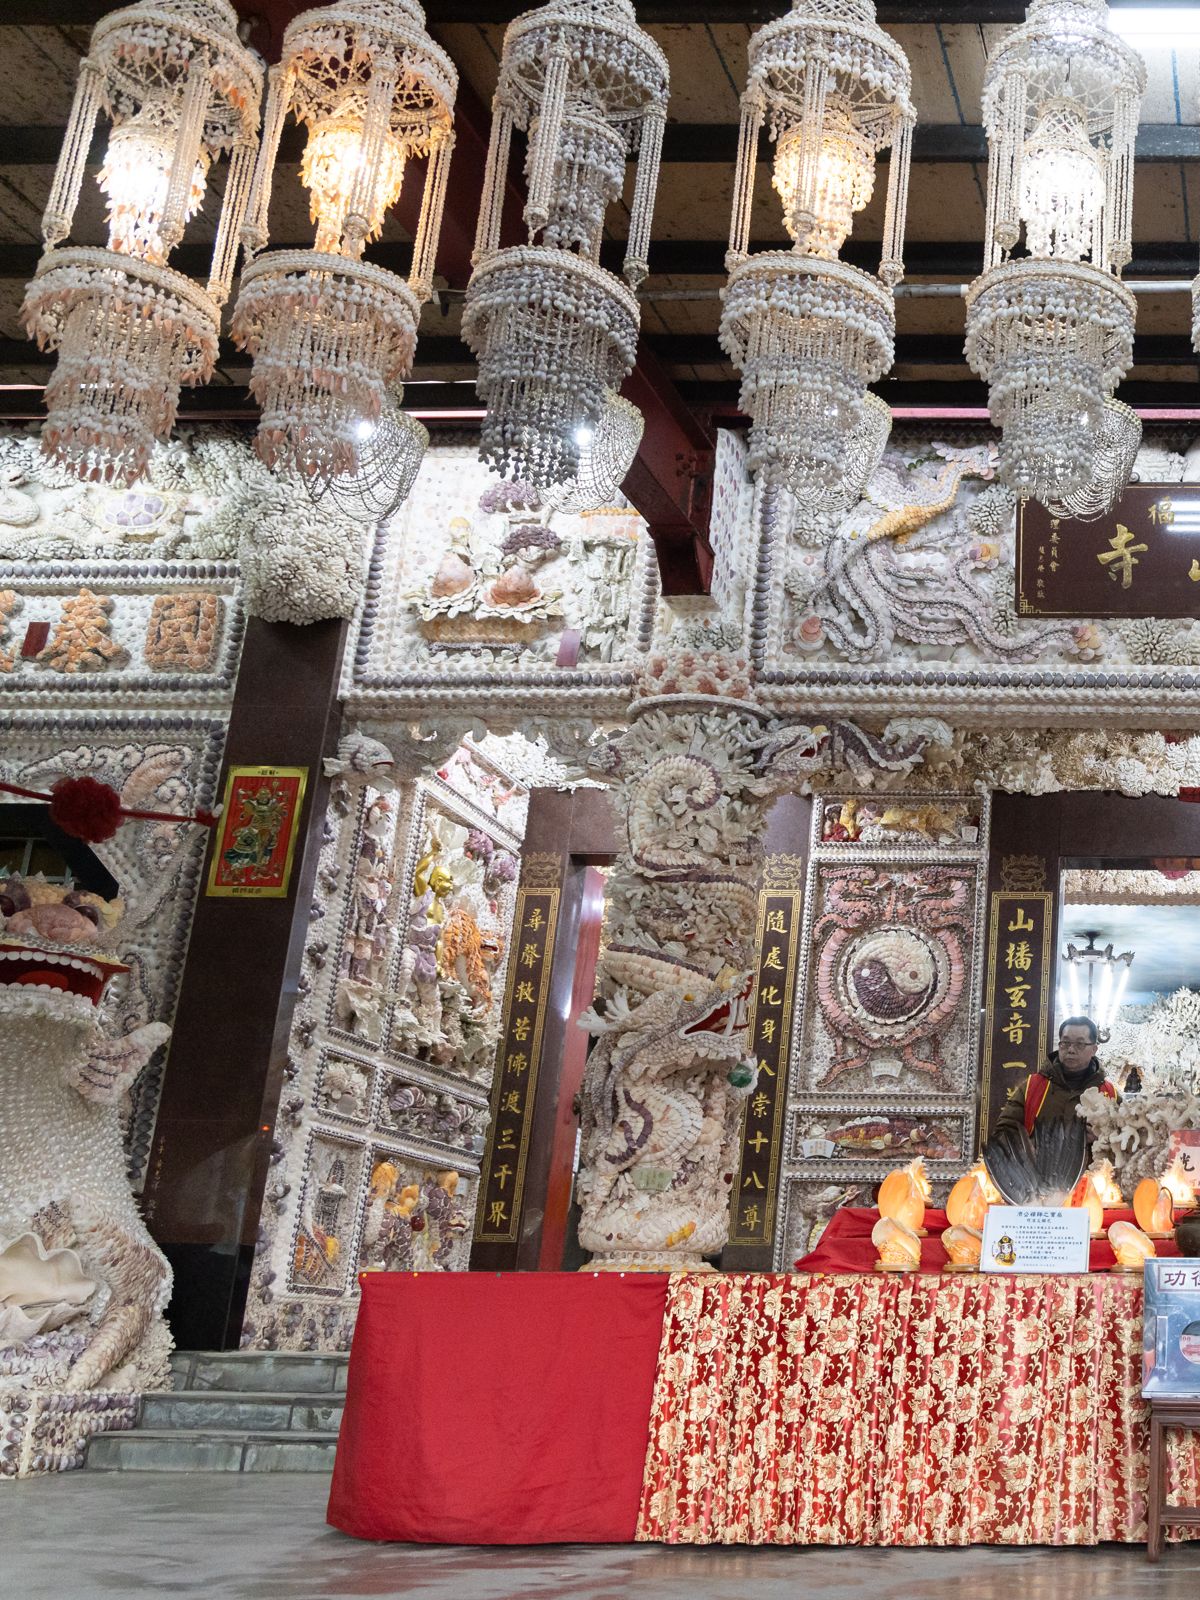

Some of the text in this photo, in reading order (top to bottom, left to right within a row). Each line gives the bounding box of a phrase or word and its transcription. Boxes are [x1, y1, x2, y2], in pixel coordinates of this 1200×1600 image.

[486, 907, 547, 1233] 尋聲救苦佛渡三千界
[1001, 907, 1035, 1100] 山播玄音一
